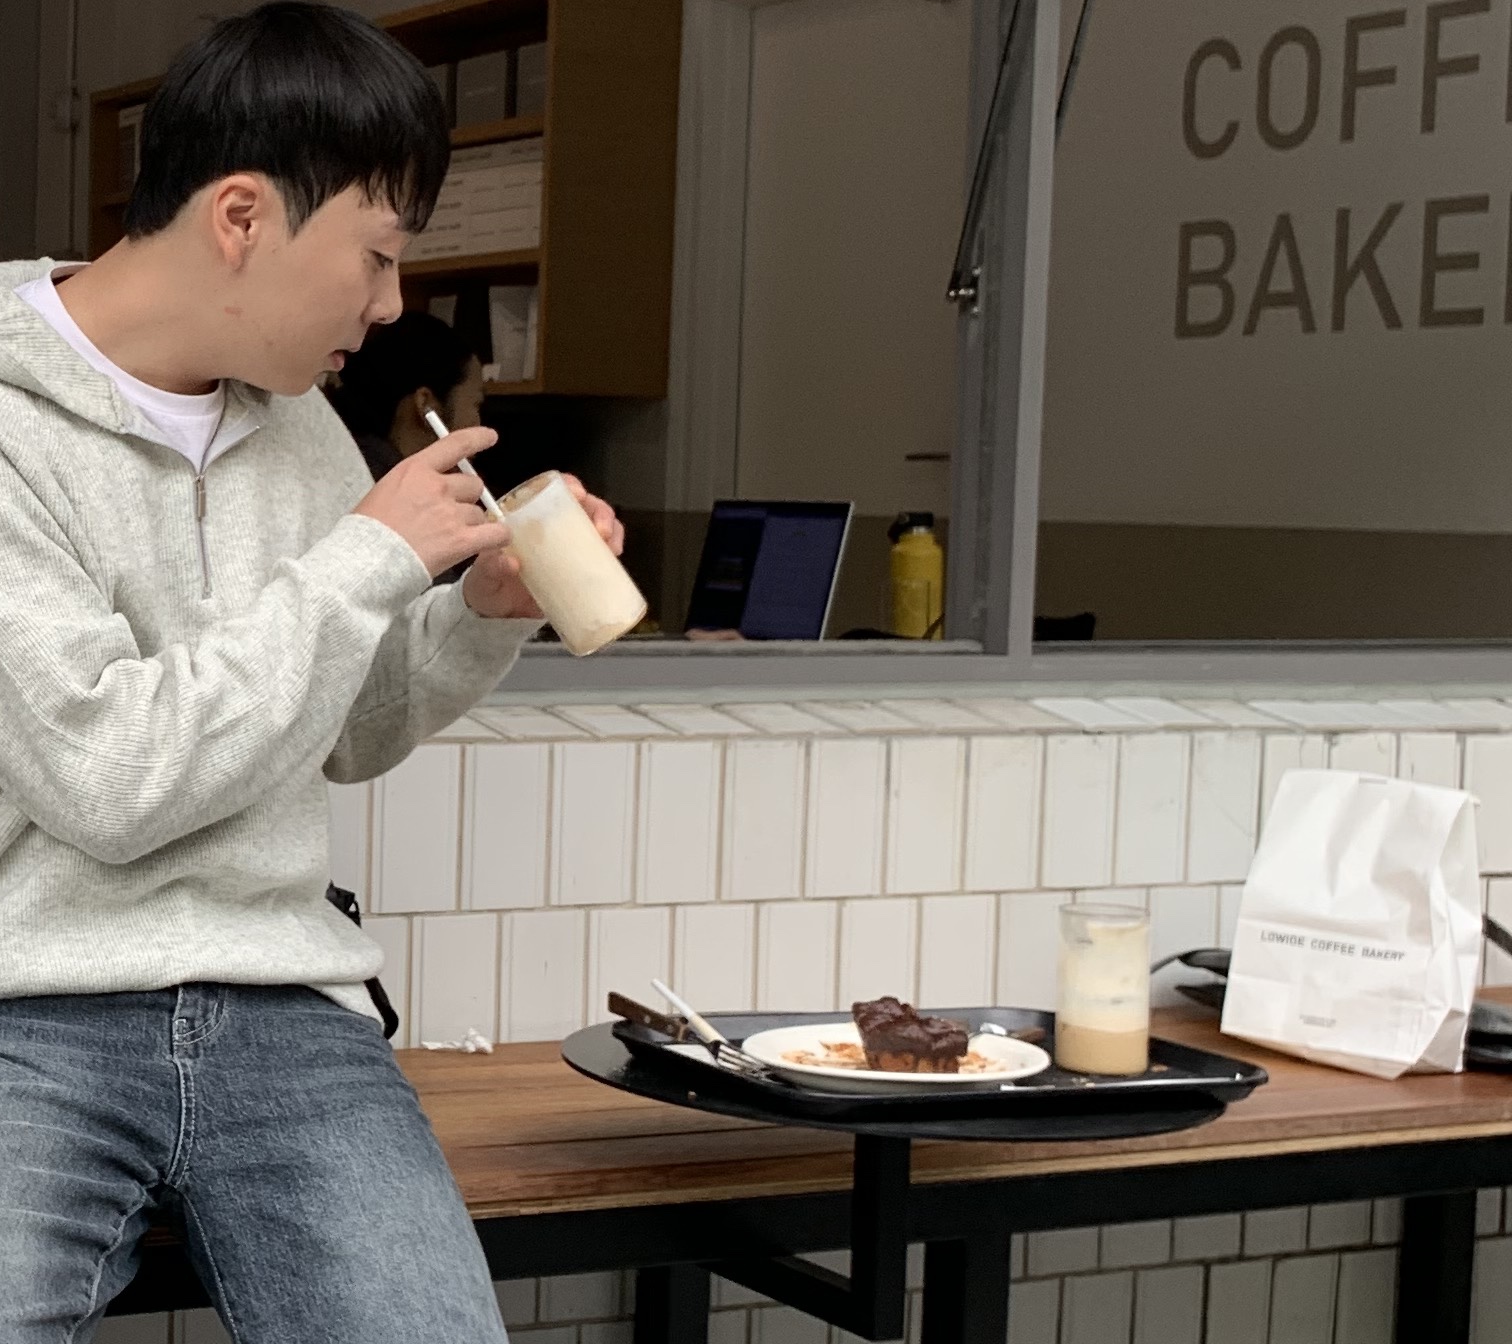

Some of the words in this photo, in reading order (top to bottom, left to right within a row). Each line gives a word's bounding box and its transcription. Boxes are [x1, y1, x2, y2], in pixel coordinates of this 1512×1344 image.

[1173, 190, 1512, 340] BAKE
[1260, 929, 1305, 947] LOWIDE
[1310, 937, 1356, 955] COFFEE
[1361, 946, 1406, 962] BAKERY
